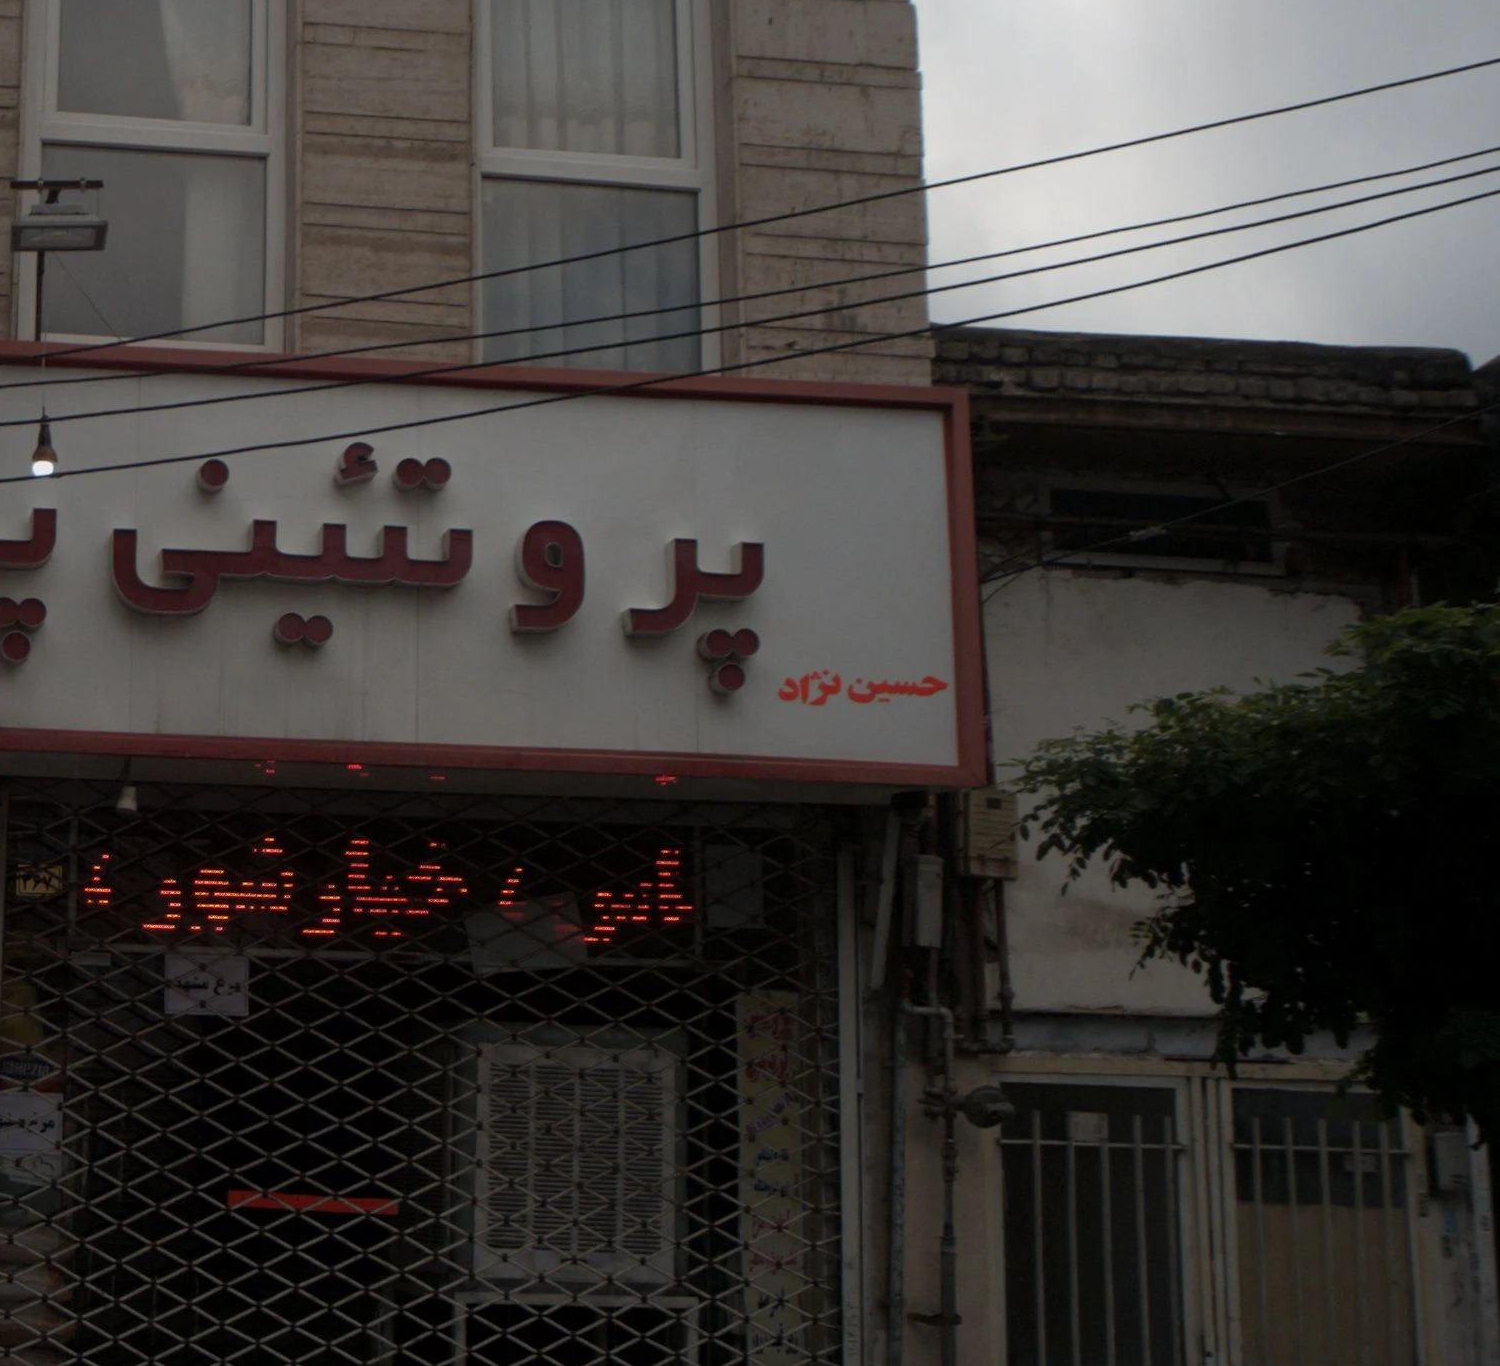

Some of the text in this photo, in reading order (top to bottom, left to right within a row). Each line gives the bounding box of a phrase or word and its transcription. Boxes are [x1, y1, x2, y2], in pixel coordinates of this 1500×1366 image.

[112, 442, 765, 695] پروتئینی
[777, 669, 949, 707] حسین نژاد
